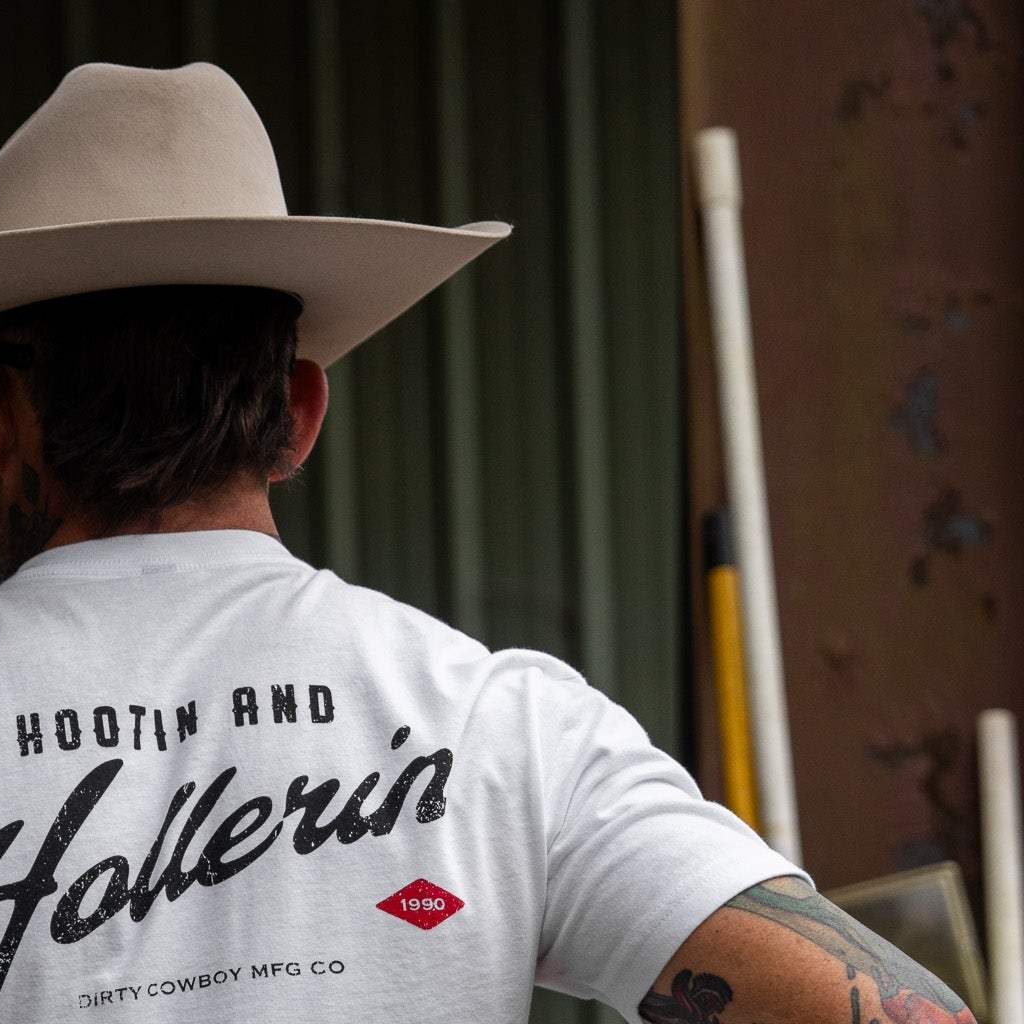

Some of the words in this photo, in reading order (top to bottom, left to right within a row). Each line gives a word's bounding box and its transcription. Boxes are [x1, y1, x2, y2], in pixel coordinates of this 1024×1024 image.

[16, 700, 198, 756] HOOTIN
[232, 684, 336, 727] AND
[400, 897, 446, 912] 1990
[78, 986, 142, 1009] DIRTY
[147, 967, 242, 997] COWBOY
[251, 962, 301, 979] MFG
[310, 960, 345, 975] CO
